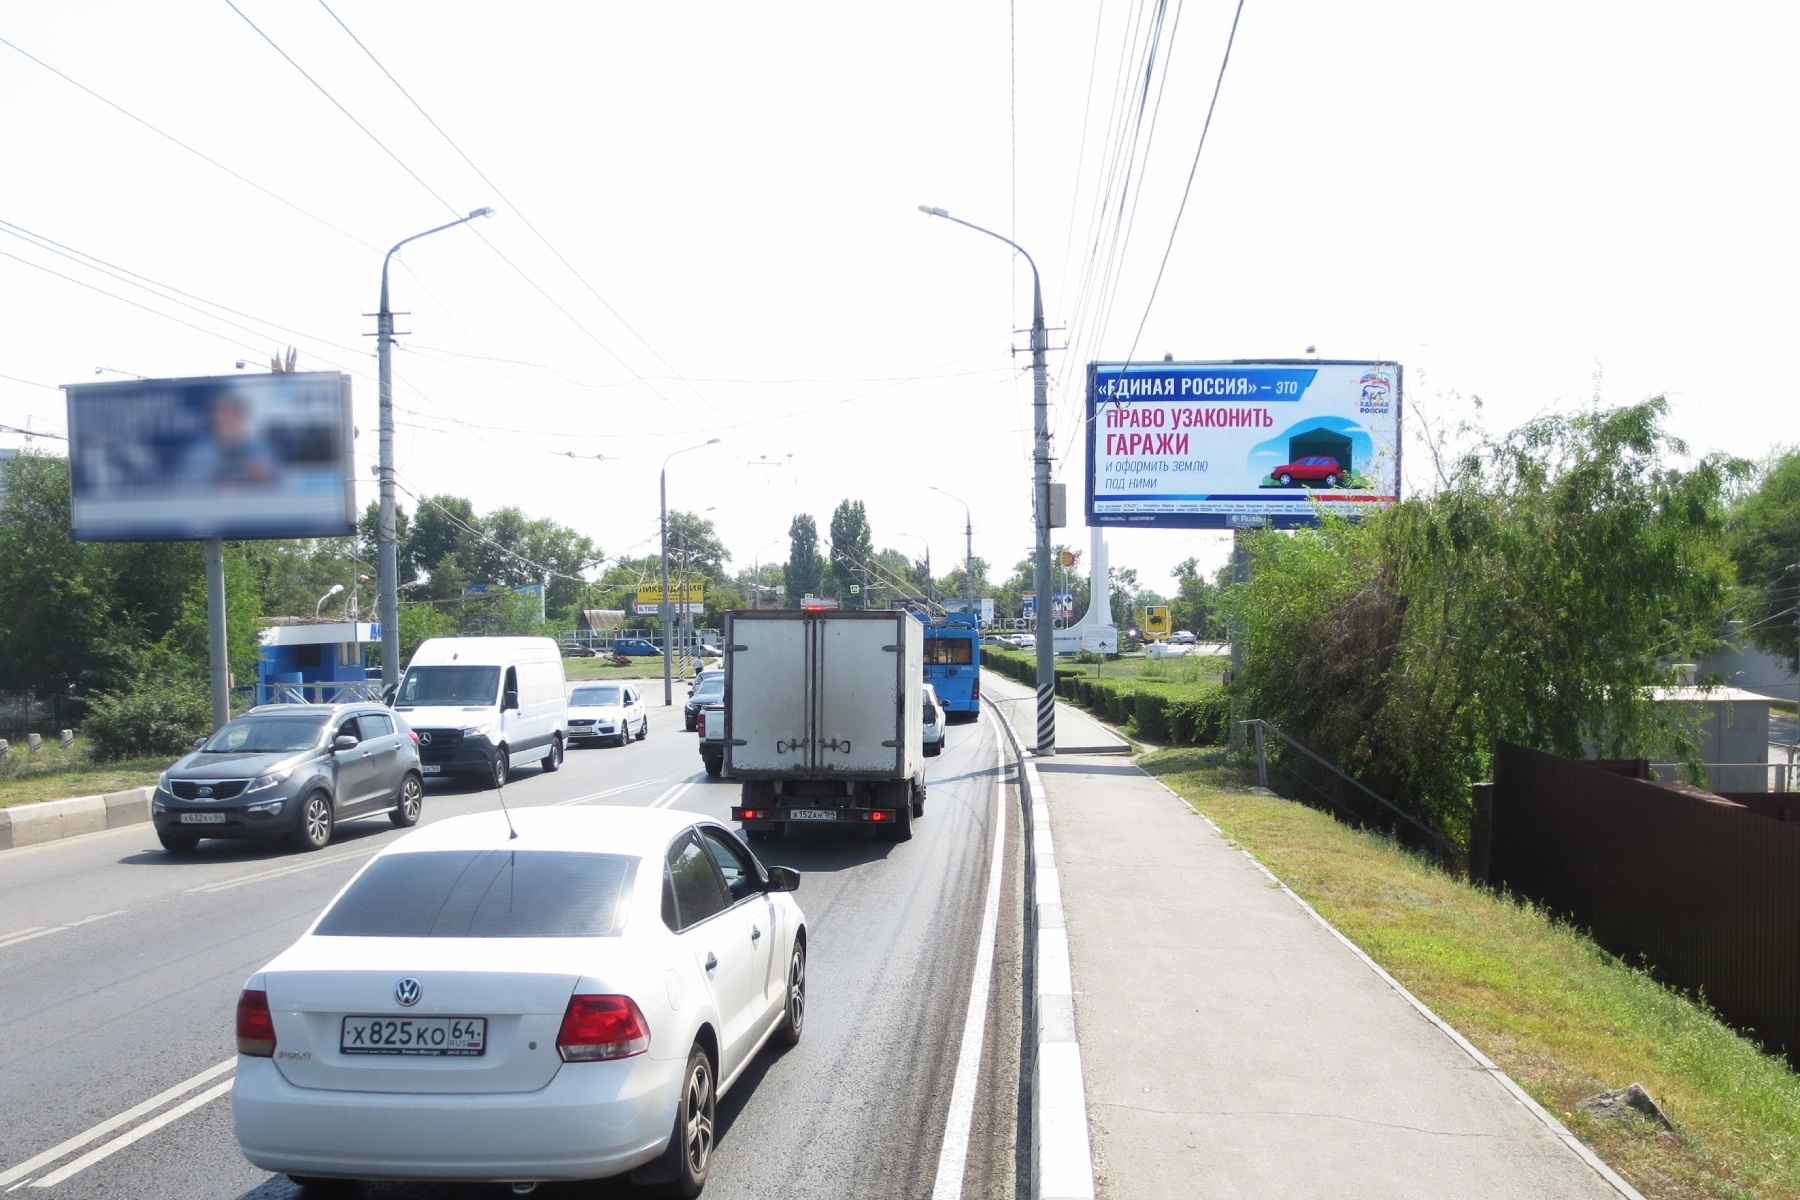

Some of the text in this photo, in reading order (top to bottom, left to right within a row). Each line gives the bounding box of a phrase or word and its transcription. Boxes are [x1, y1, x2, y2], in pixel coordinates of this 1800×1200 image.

[1098, 378, 1174, 398] «ЕДИНАЯ
[1181, 377, 1258, 395] РОССИЯ»
[1106, 407, 1273, 430] ПРАВО УЗАКОНИТЬ
[1106, 433, 1189, 456] ГАРАЖИ
[1105, 457, 1209, 474] и оформить землю
[1105, 477, 1157, 491] под ними
[638, 584, 702, 593] ЛИКВДАЦИЯ
[451, 1021, 475, 1040] 64
